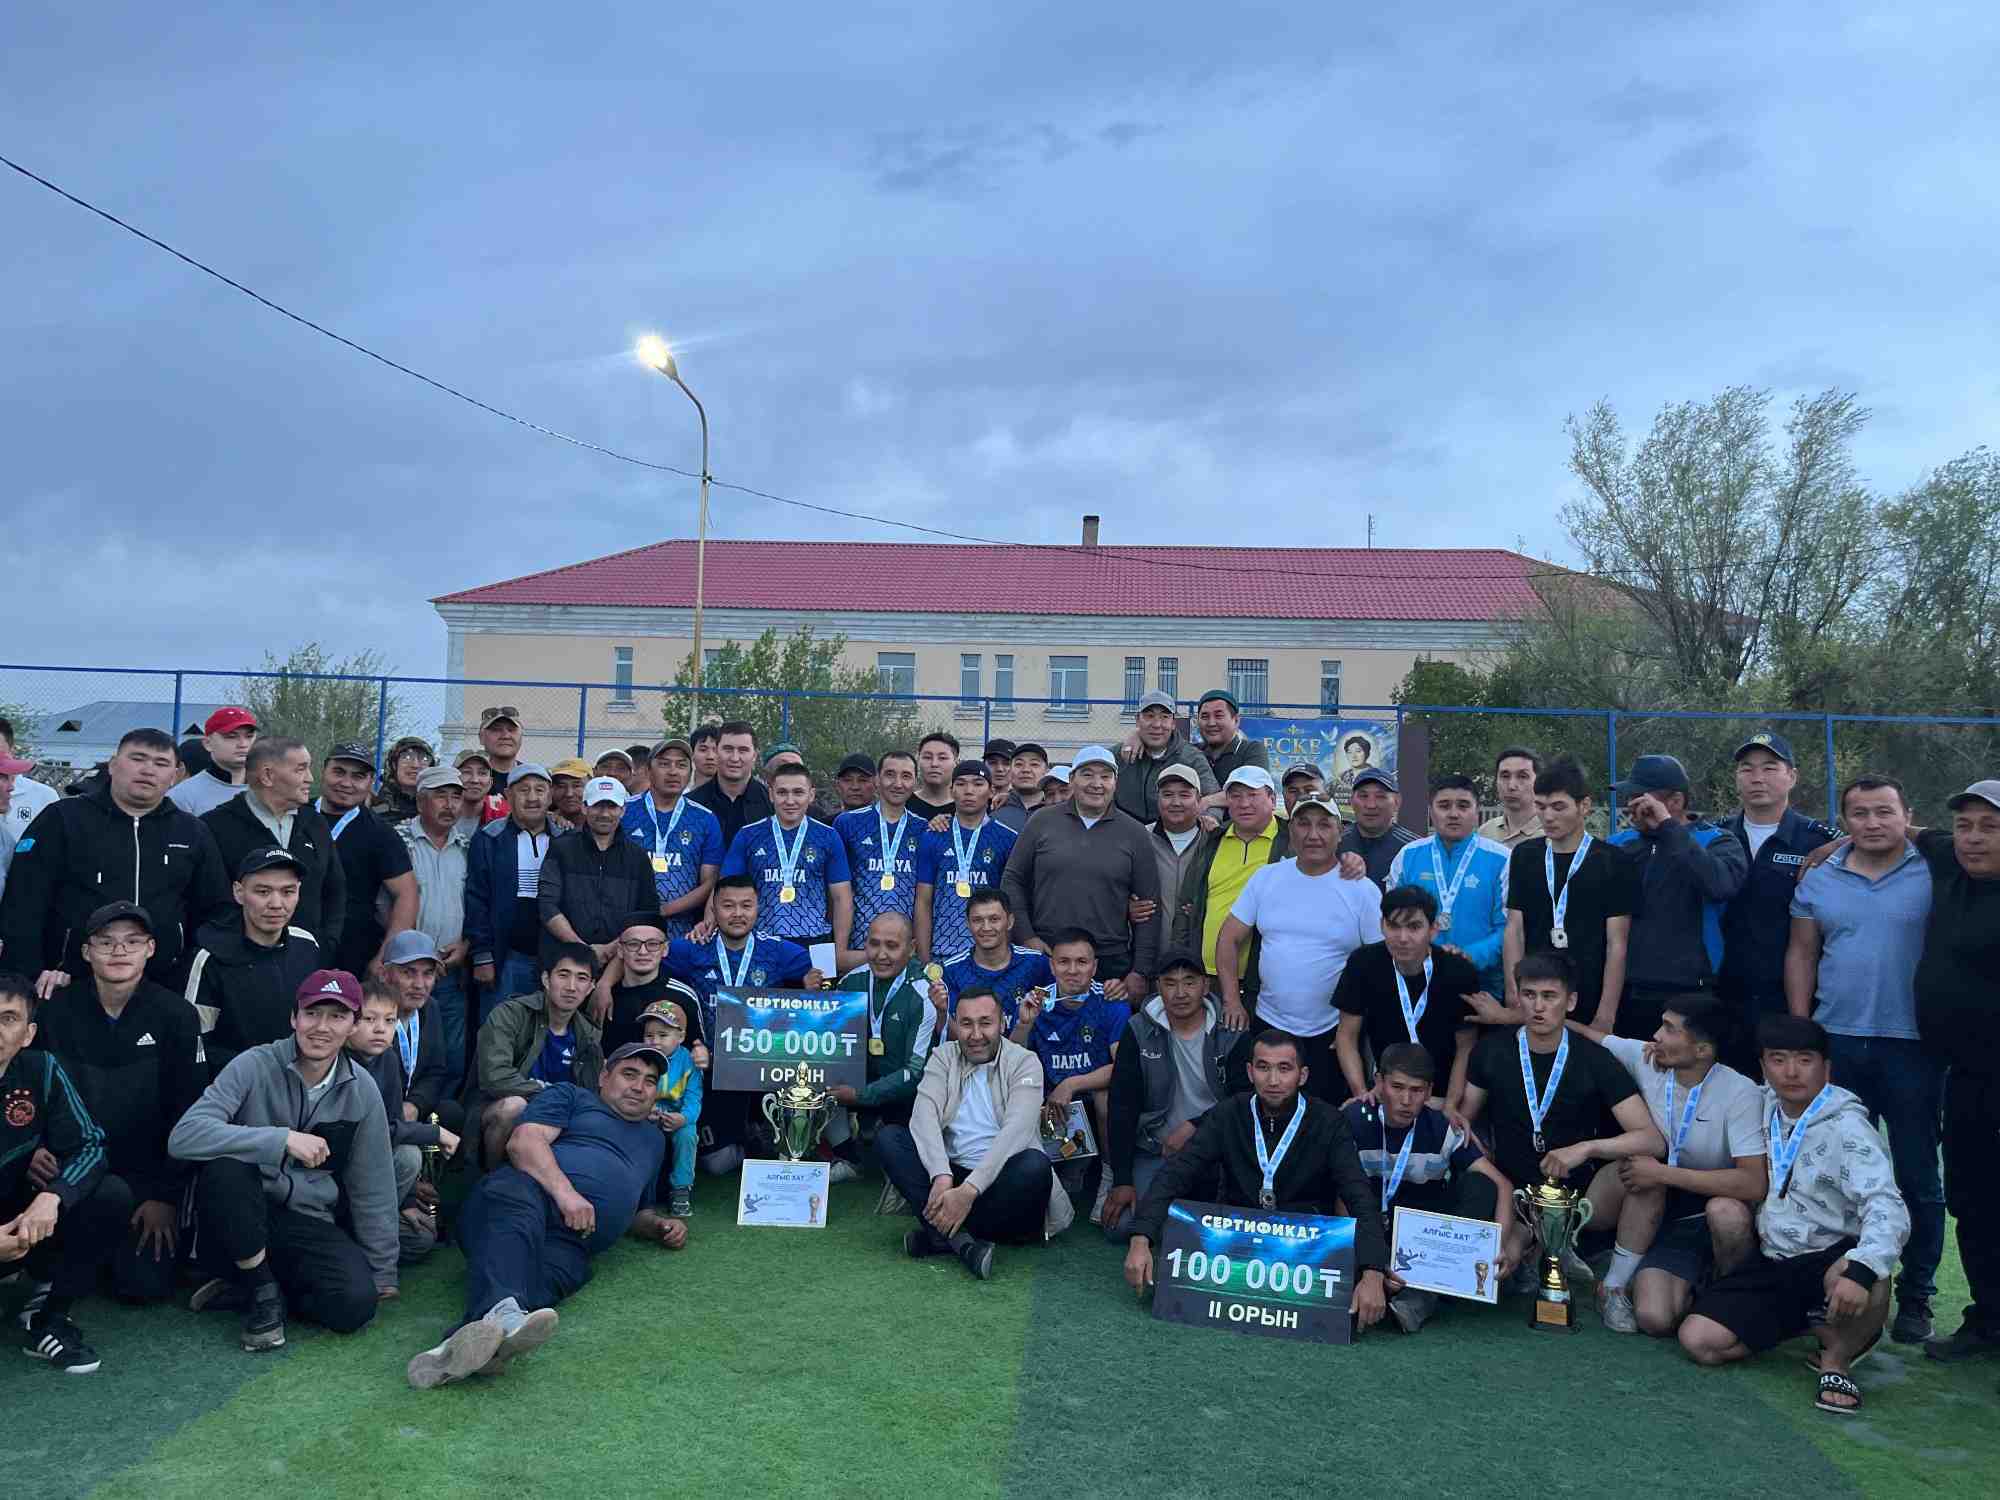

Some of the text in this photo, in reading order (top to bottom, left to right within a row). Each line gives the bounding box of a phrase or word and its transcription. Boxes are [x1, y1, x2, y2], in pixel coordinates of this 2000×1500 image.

[868, 858, 912, 872] DAYA
[764, 869, 806, 882] DAYA
[946, 870, 988, 884] DAYA
[746, 997, 839, 1011] СЕРТИФИКАТ
[720, 1027, 773, 1054] 150
[1201, 1214, 1320, 1239] СЕРТИФИКАТ
[1167, 1248, 1231, 1285] 100
[1228, 1303, 1298, 1329] ОРЫН
